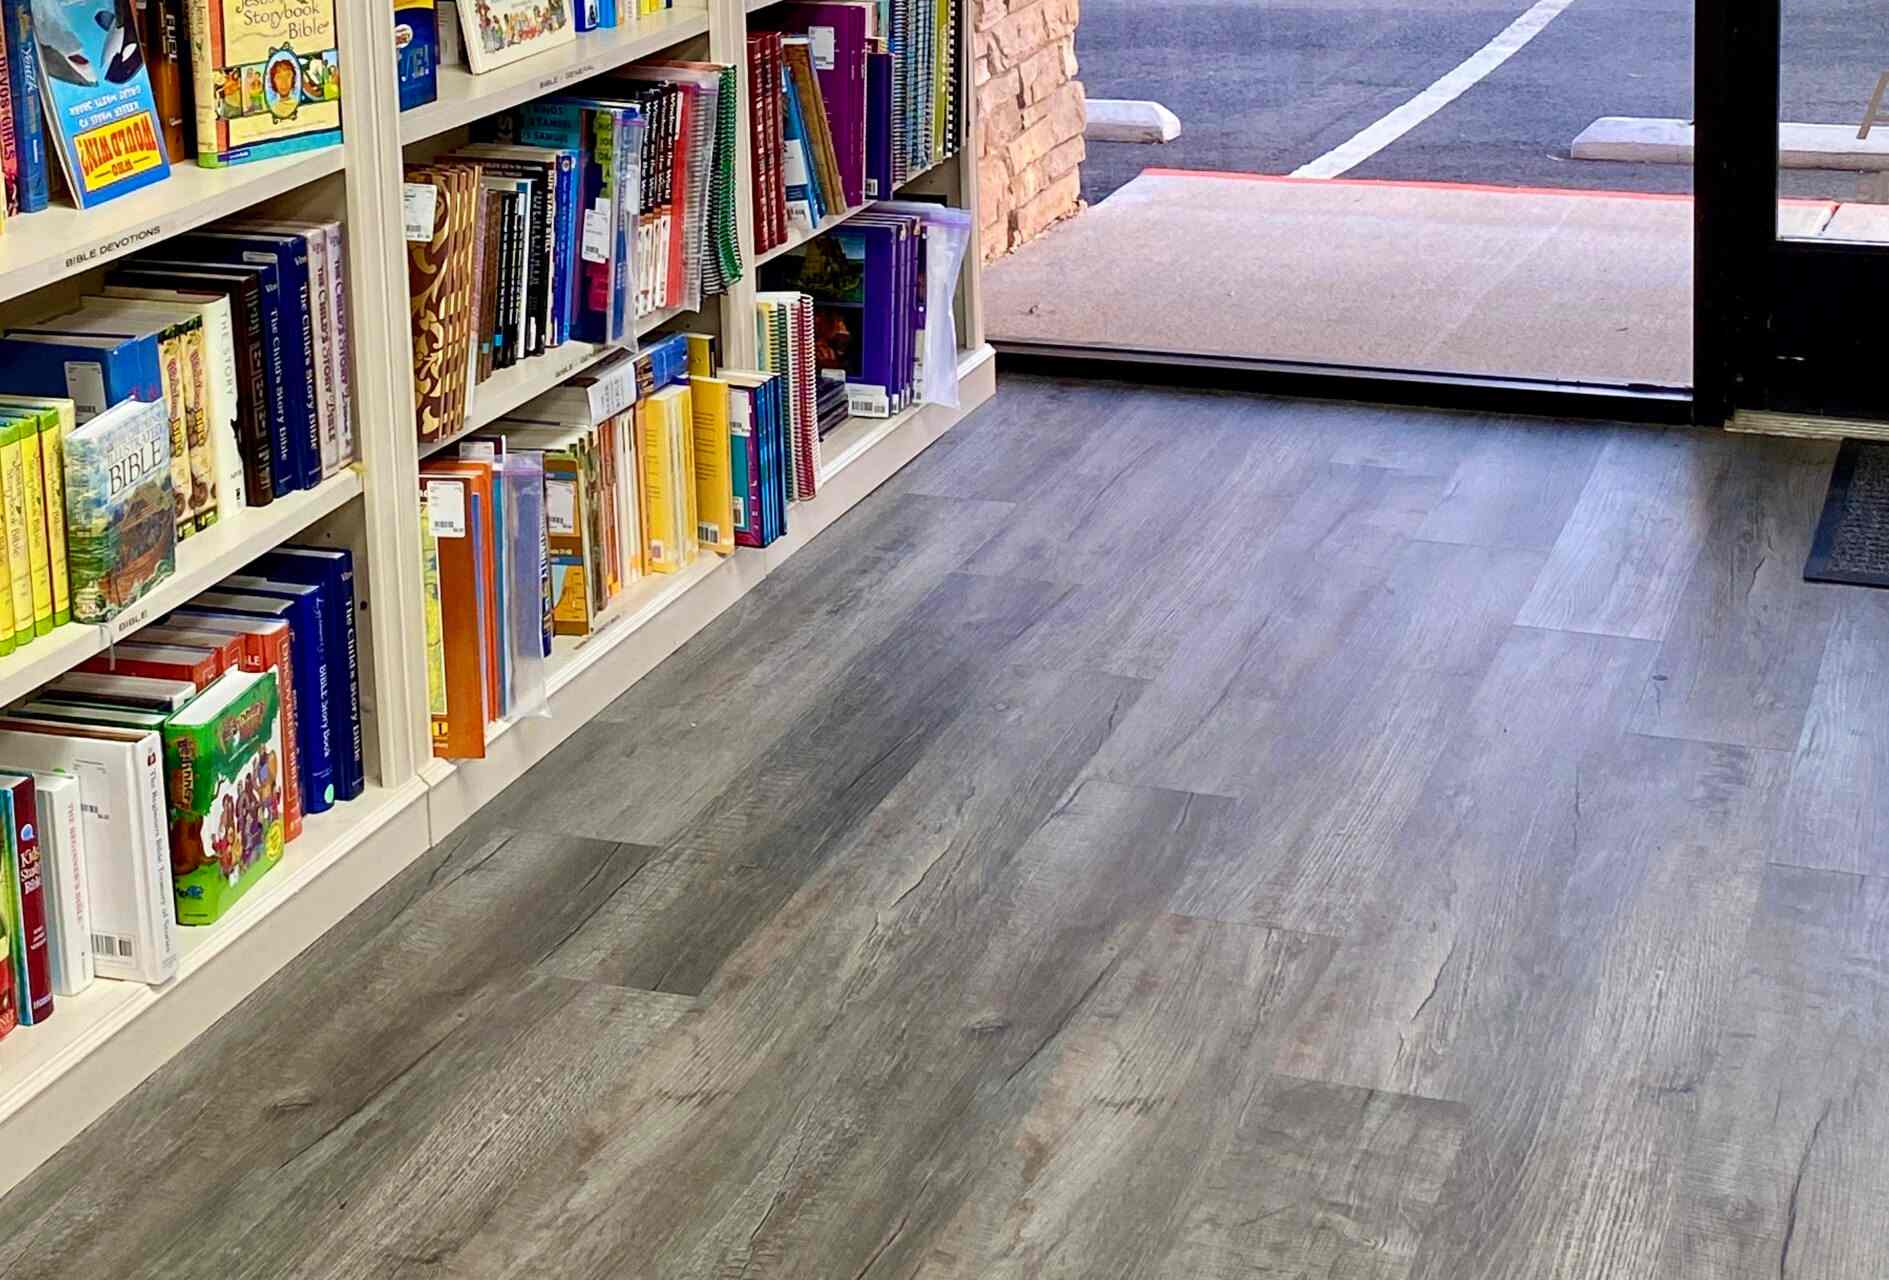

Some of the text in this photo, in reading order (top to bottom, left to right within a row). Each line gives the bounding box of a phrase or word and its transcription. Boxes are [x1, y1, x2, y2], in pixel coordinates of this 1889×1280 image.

[243, 0, 320, 27] Storybook
[289, 19, 330, 40] Bible
[111, 115, 157, 157] WOULD
[65, 225, 161, 268] BIBLE DEVOTIONS
[318, 289, 330, 345] CHILD'S
[269, 308, 289, 461] The Child's Story Bible
[299, 282, 319, 450] The Child's Story Bible
[321, 346, 332, 394] STORY
[109, 437, 162, 494] BIBLE
[118, 609, 149, 634] BIBLE
[344, 598, 363, 762] The Child's Story Bible
